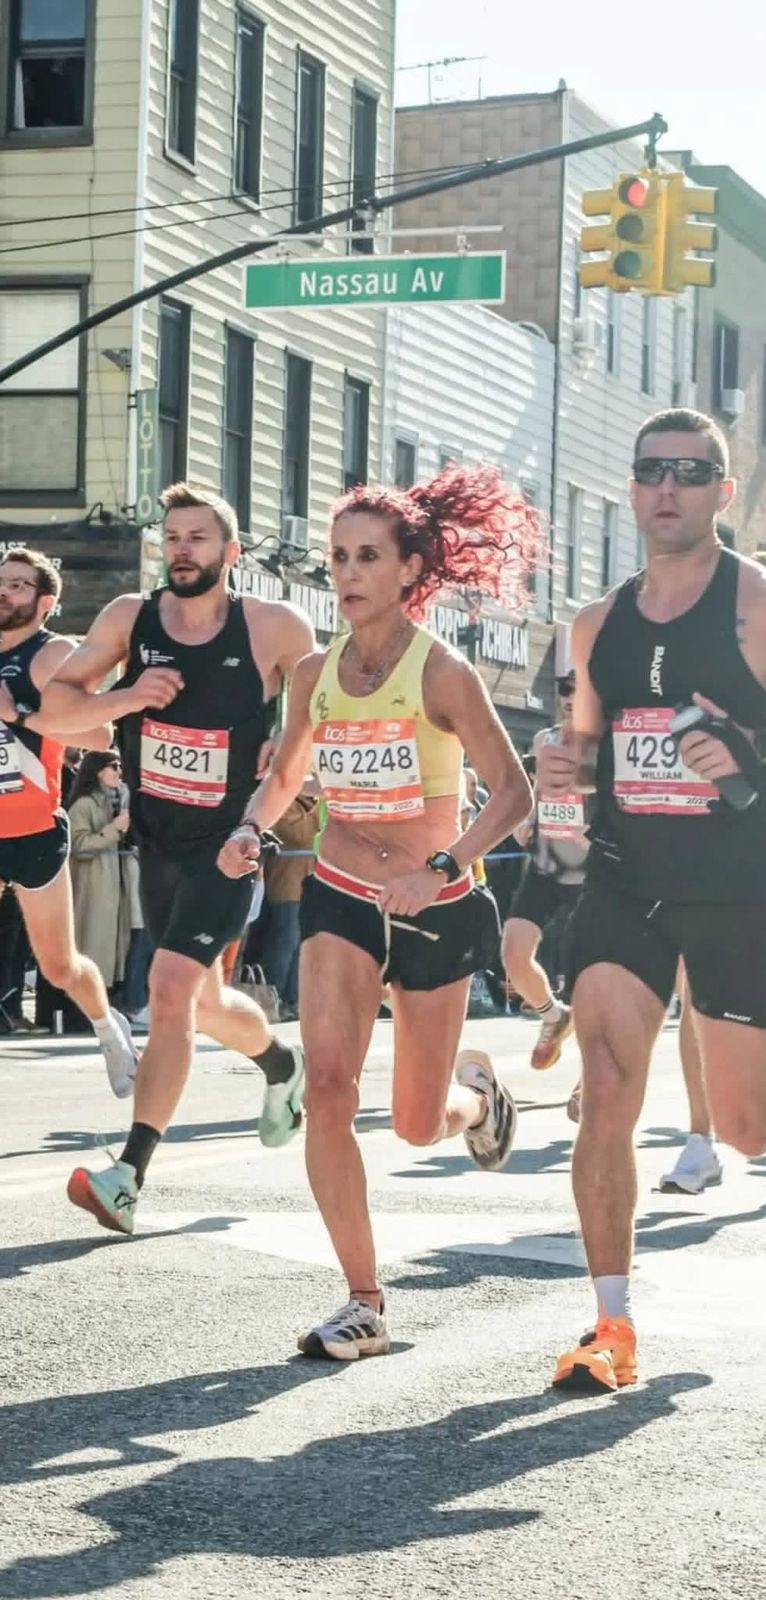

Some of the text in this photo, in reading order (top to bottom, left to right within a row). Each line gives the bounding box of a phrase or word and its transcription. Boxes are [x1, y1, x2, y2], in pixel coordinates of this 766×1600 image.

[300, 267, 445, 297] Nassau Av
[140, 393, 153, 518] LOTTO
[481, 617, 529, 667] ICHIBAN
[650, 646, 665, 696] BANDIT
[154, 743, 209, 773] 4821
[319, 745, 412, 774] AG 2248
[626, 735, 678, 768] 429
[350, 780, 378, 788] MARIA
[640, 771, 682, 780] WILLIAM
[543, 804, 576, 820] 4489
